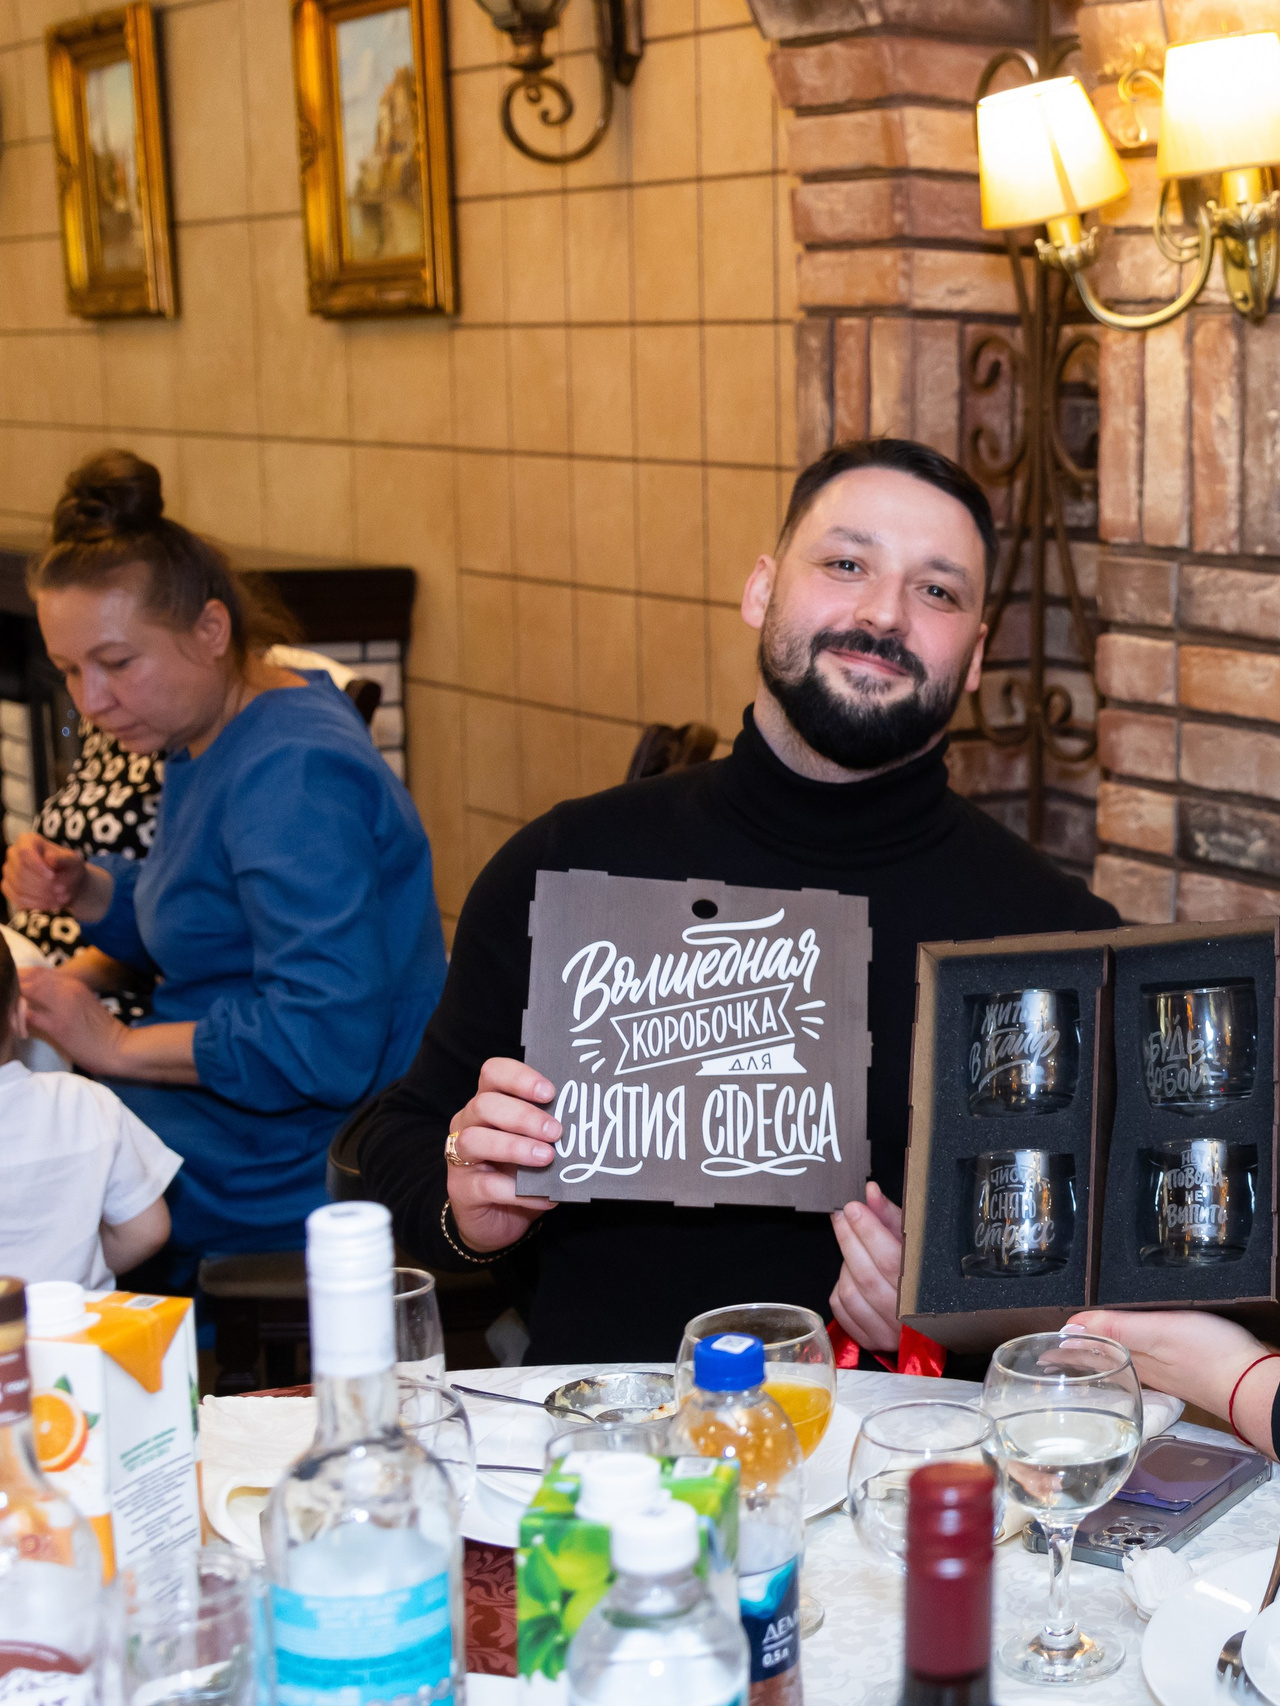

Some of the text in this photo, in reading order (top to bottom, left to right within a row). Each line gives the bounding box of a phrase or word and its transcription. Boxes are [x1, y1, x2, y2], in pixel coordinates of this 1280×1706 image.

[562, 908, 820, 1032] Волшебная
[632, 997, 778, 1060] КОРОБОЧКА
[728, 1053, 772, 1071] ДЛЯ
[555, 1080, 842, 1183] СНЯТИЯ СТРЕССА
[990, 1191, 1037, 1220] СНЯТЬ
[1185, 1190, 1204, 1203] НЕ
